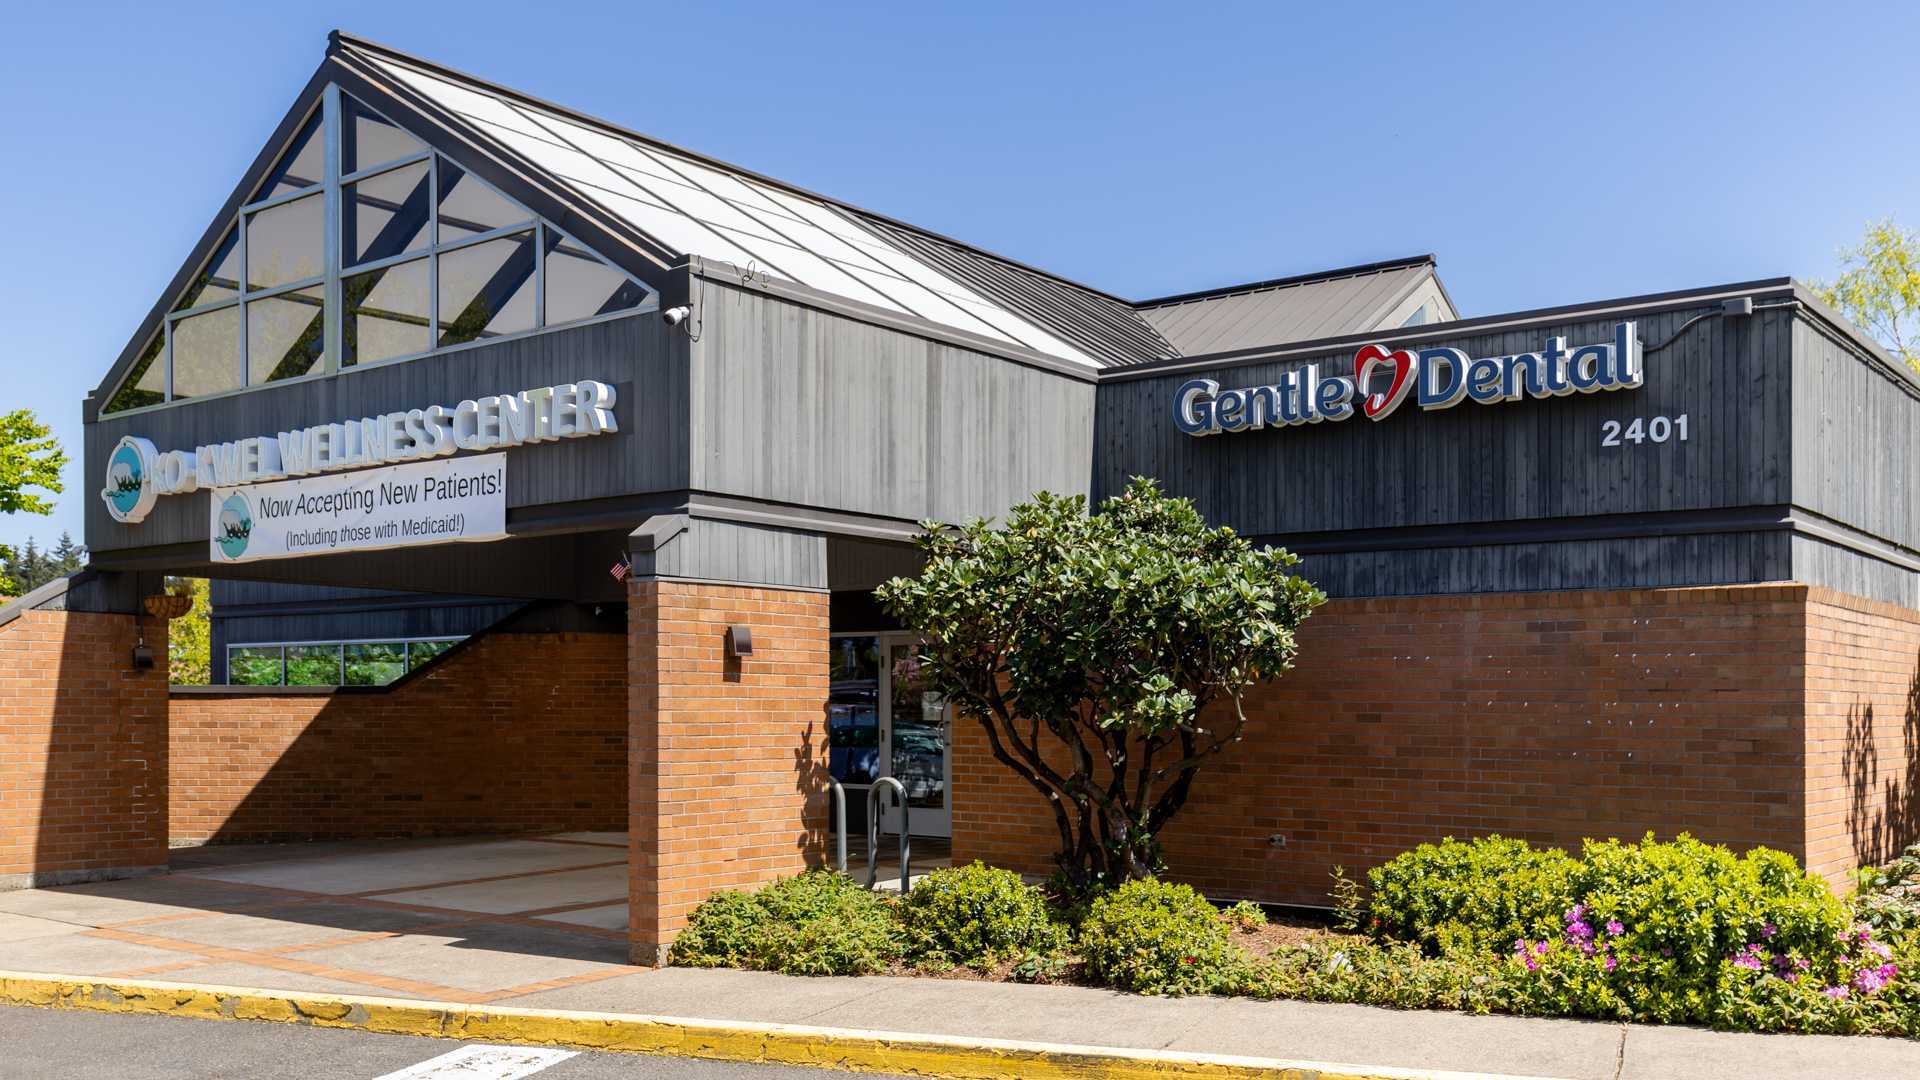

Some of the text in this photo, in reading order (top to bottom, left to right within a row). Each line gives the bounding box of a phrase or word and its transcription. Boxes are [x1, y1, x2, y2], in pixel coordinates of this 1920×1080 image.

[1173, 321, 1643, 436] Gentle Dental
[278, 405, 455, 476] WELLNESS
[453, 380, 616, 450] CENTER
[1602, 414, 1688, 447] 2401
[259, 468, 502, 519] Now Accepting New Patients!
[286, 513, 465, 551] (Including those with Medicaid!)
